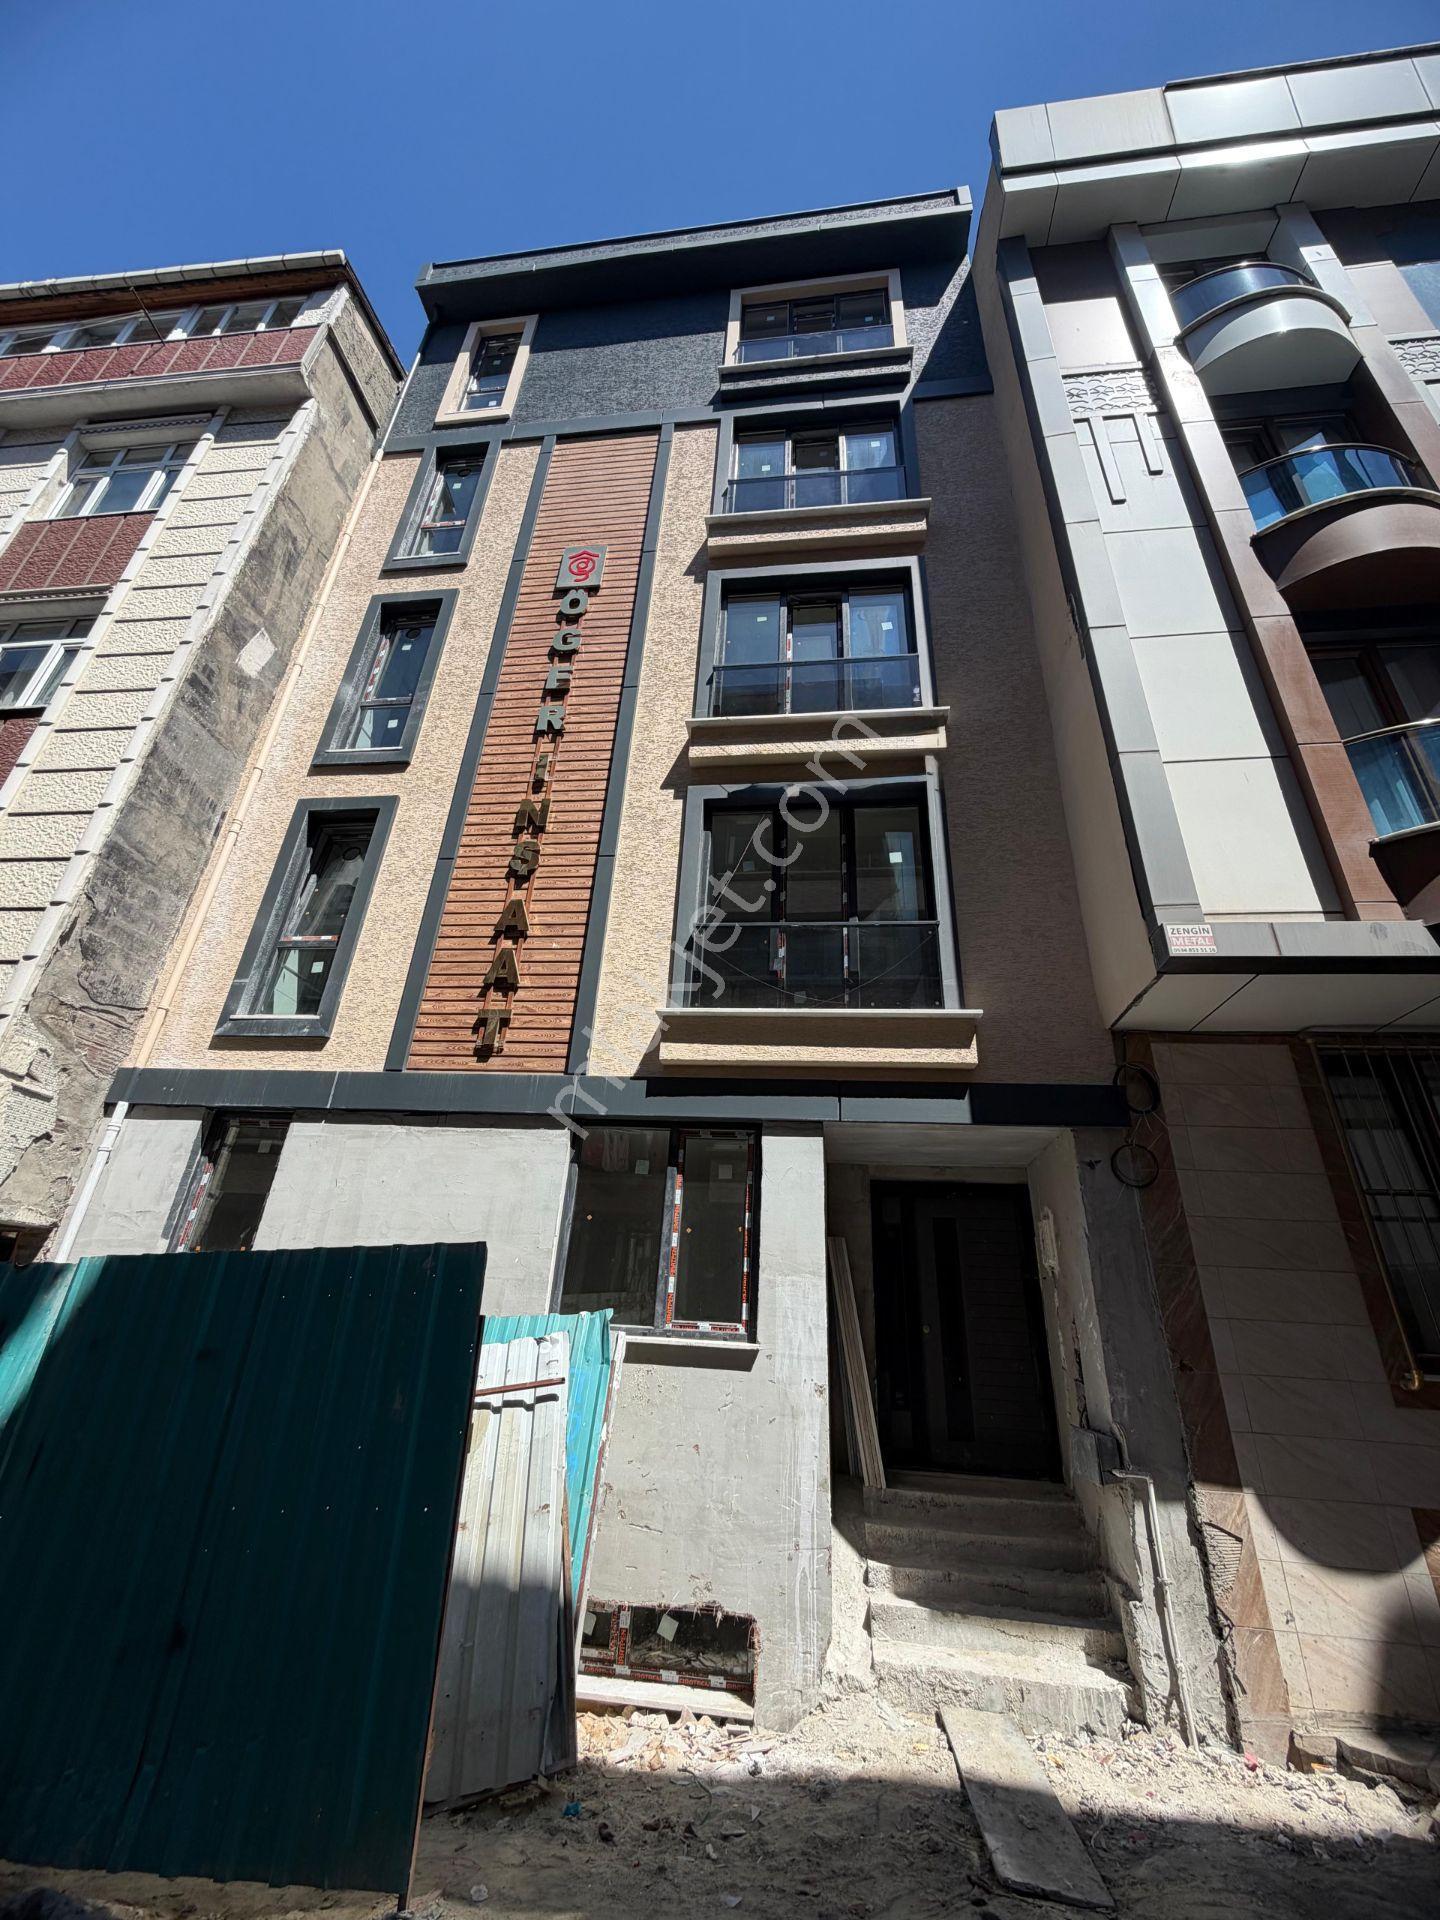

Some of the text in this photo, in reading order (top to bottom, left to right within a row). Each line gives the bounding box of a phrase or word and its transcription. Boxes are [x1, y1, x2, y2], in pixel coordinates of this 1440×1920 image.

[477, 588, 589, 1046] ÖGER İNŞAAT
[1170, 926, 1210, 935] ZENGİN
[1172, 936, 1215, 946] METAL
